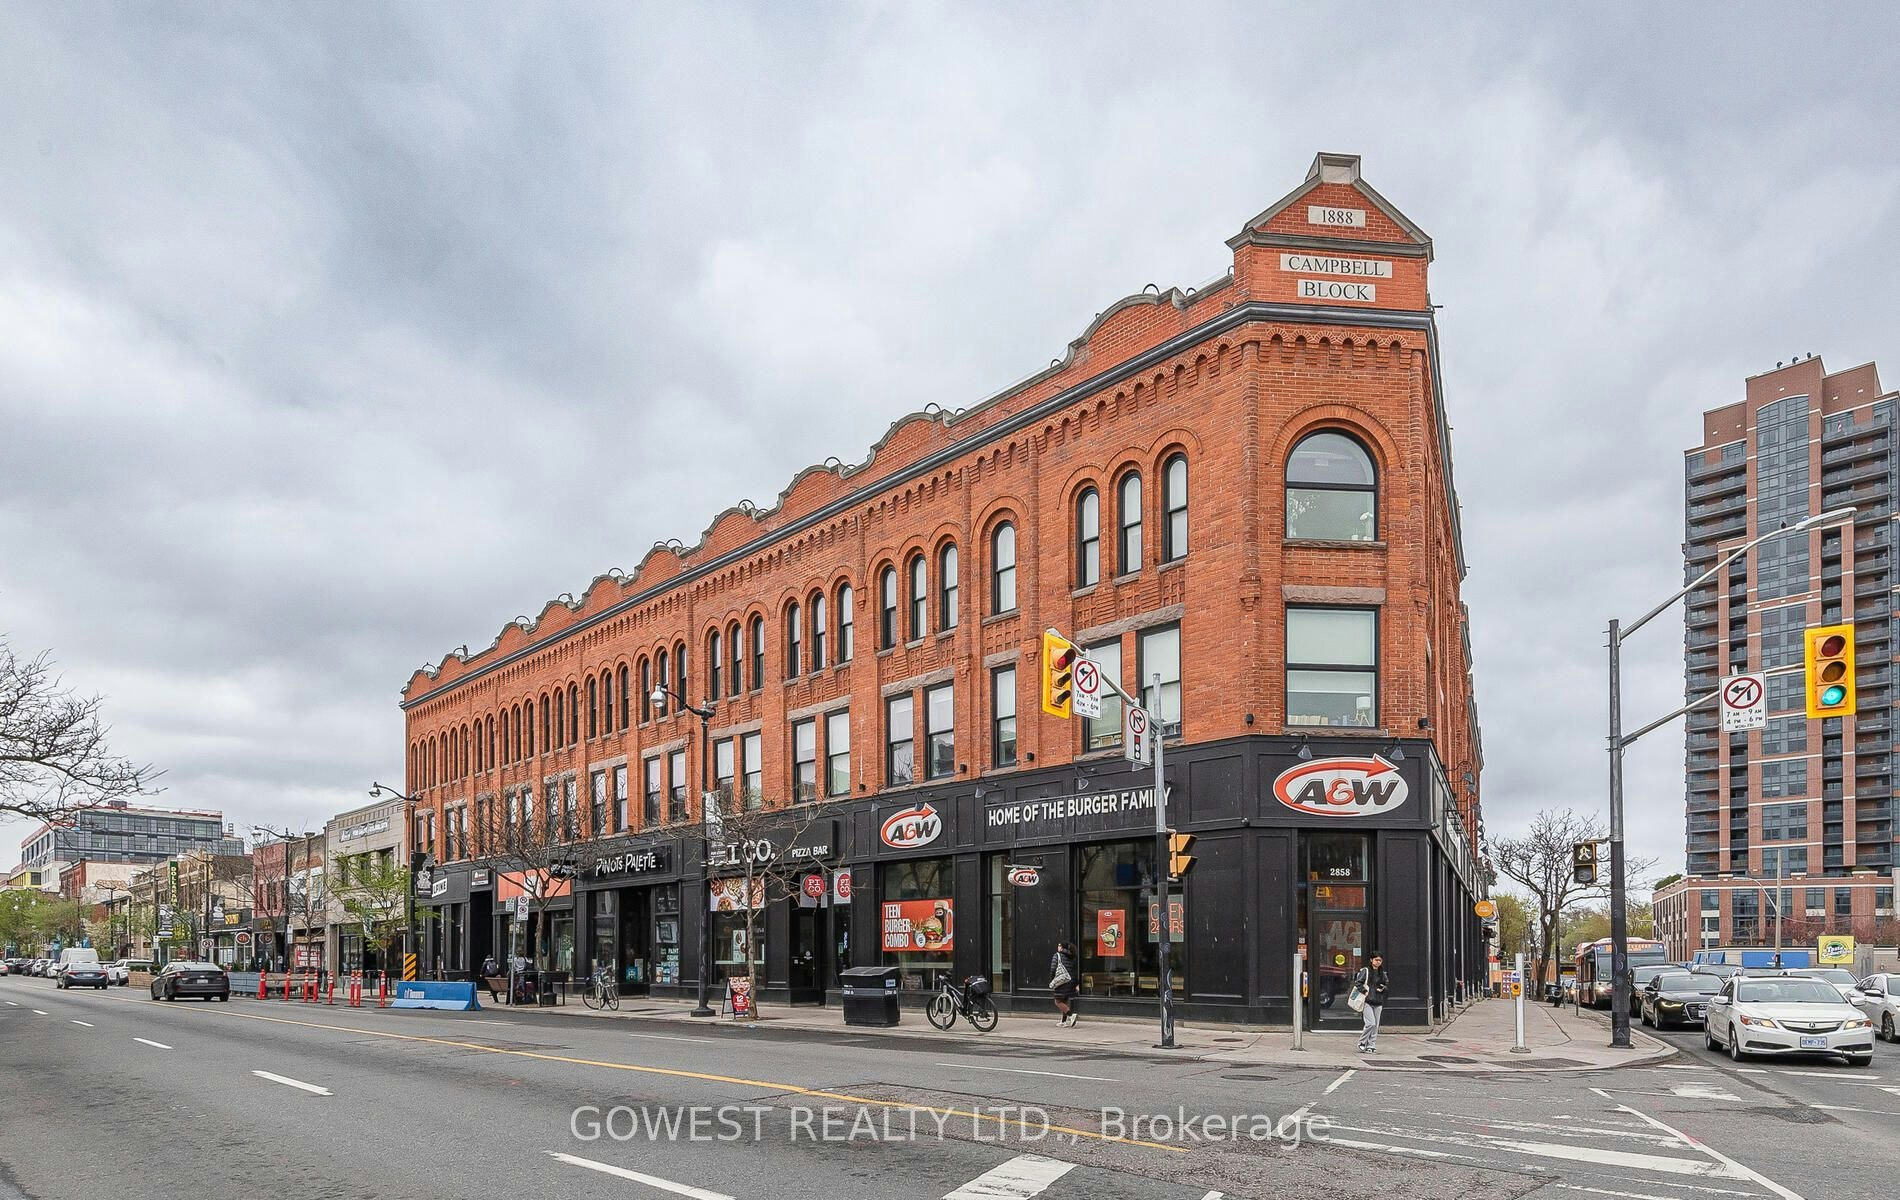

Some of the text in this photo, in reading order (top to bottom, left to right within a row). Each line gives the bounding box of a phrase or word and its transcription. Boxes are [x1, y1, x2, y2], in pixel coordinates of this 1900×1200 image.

[1322, 209, 1353, 224] 1888
[1288, 256, 1385, 276] CAMPBELL
[1304, 281, 1370, 300] BLOCK
[1292, 779, 1400, 806] A&W
[988, 787, 1171, 827] HOME OF THE BURGER FAMIY
[890, 819, 938, 842] A&W
[791, 845, 829, 858] PIZZA BAR
[625, 852, 657, 873] PALETTE
[1018, 875, 1038, 884] A&W
[1330, 867, 1351, 876] 2858
[884, 904, 901, 919] TEEN
[1150, 903, 1184, 921] OEN
[884, 918, 911, 933] BURGER
[884, 933, 909, 948] COMBO
